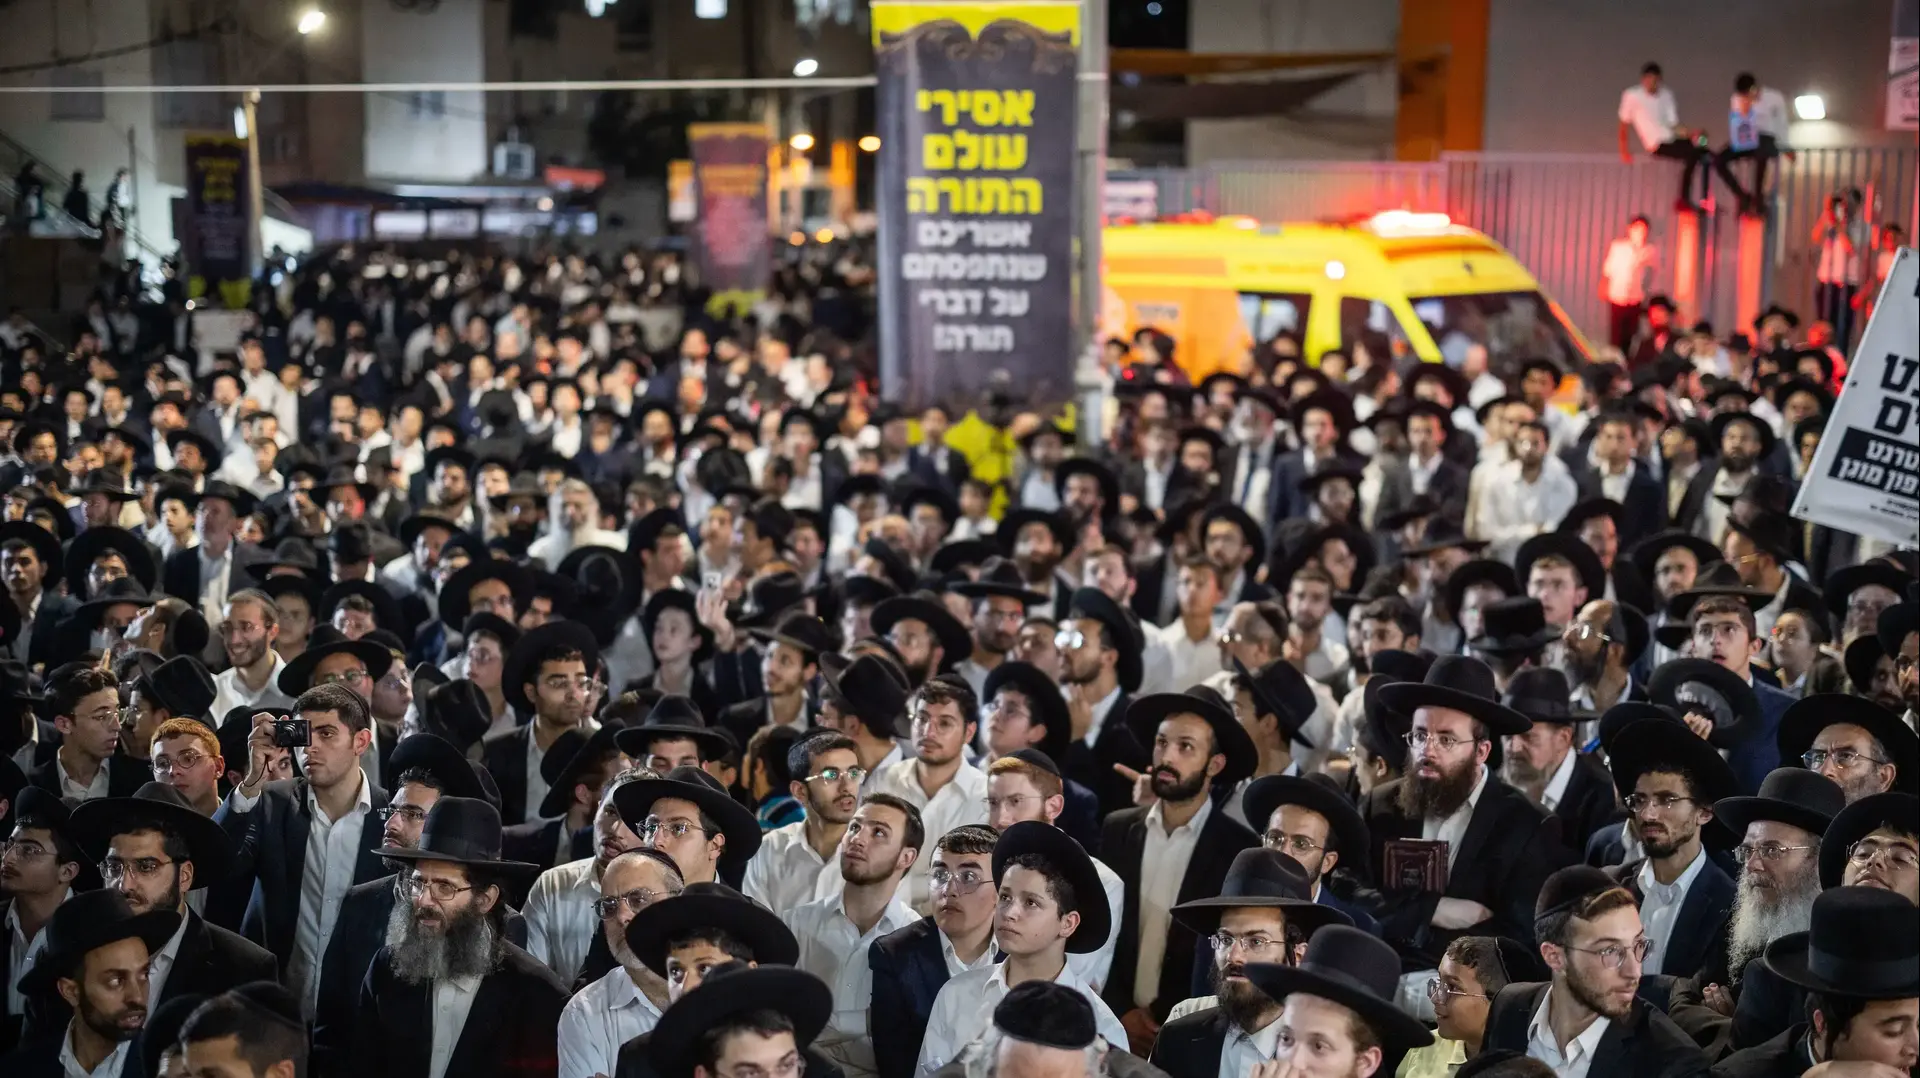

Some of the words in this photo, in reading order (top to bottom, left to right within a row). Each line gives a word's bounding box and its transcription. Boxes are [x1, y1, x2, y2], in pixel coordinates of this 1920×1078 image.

[915, 89, 1036, 126] אסירי
[922, 129, 1028, 170] עולם
[907, 176, 1043, 214] התורה
[918, 220, 1032, 247] אשריכם
[902, 252, 1047, 281] שנתפסתם
[919, 289, 984, 315] דברי
[987, 287, 1030, 316] על
[933, 324, 1014, 352] תורה!
[1880, 353, 1919, 397] ט
[1874, 396, 1919, 435] ם
